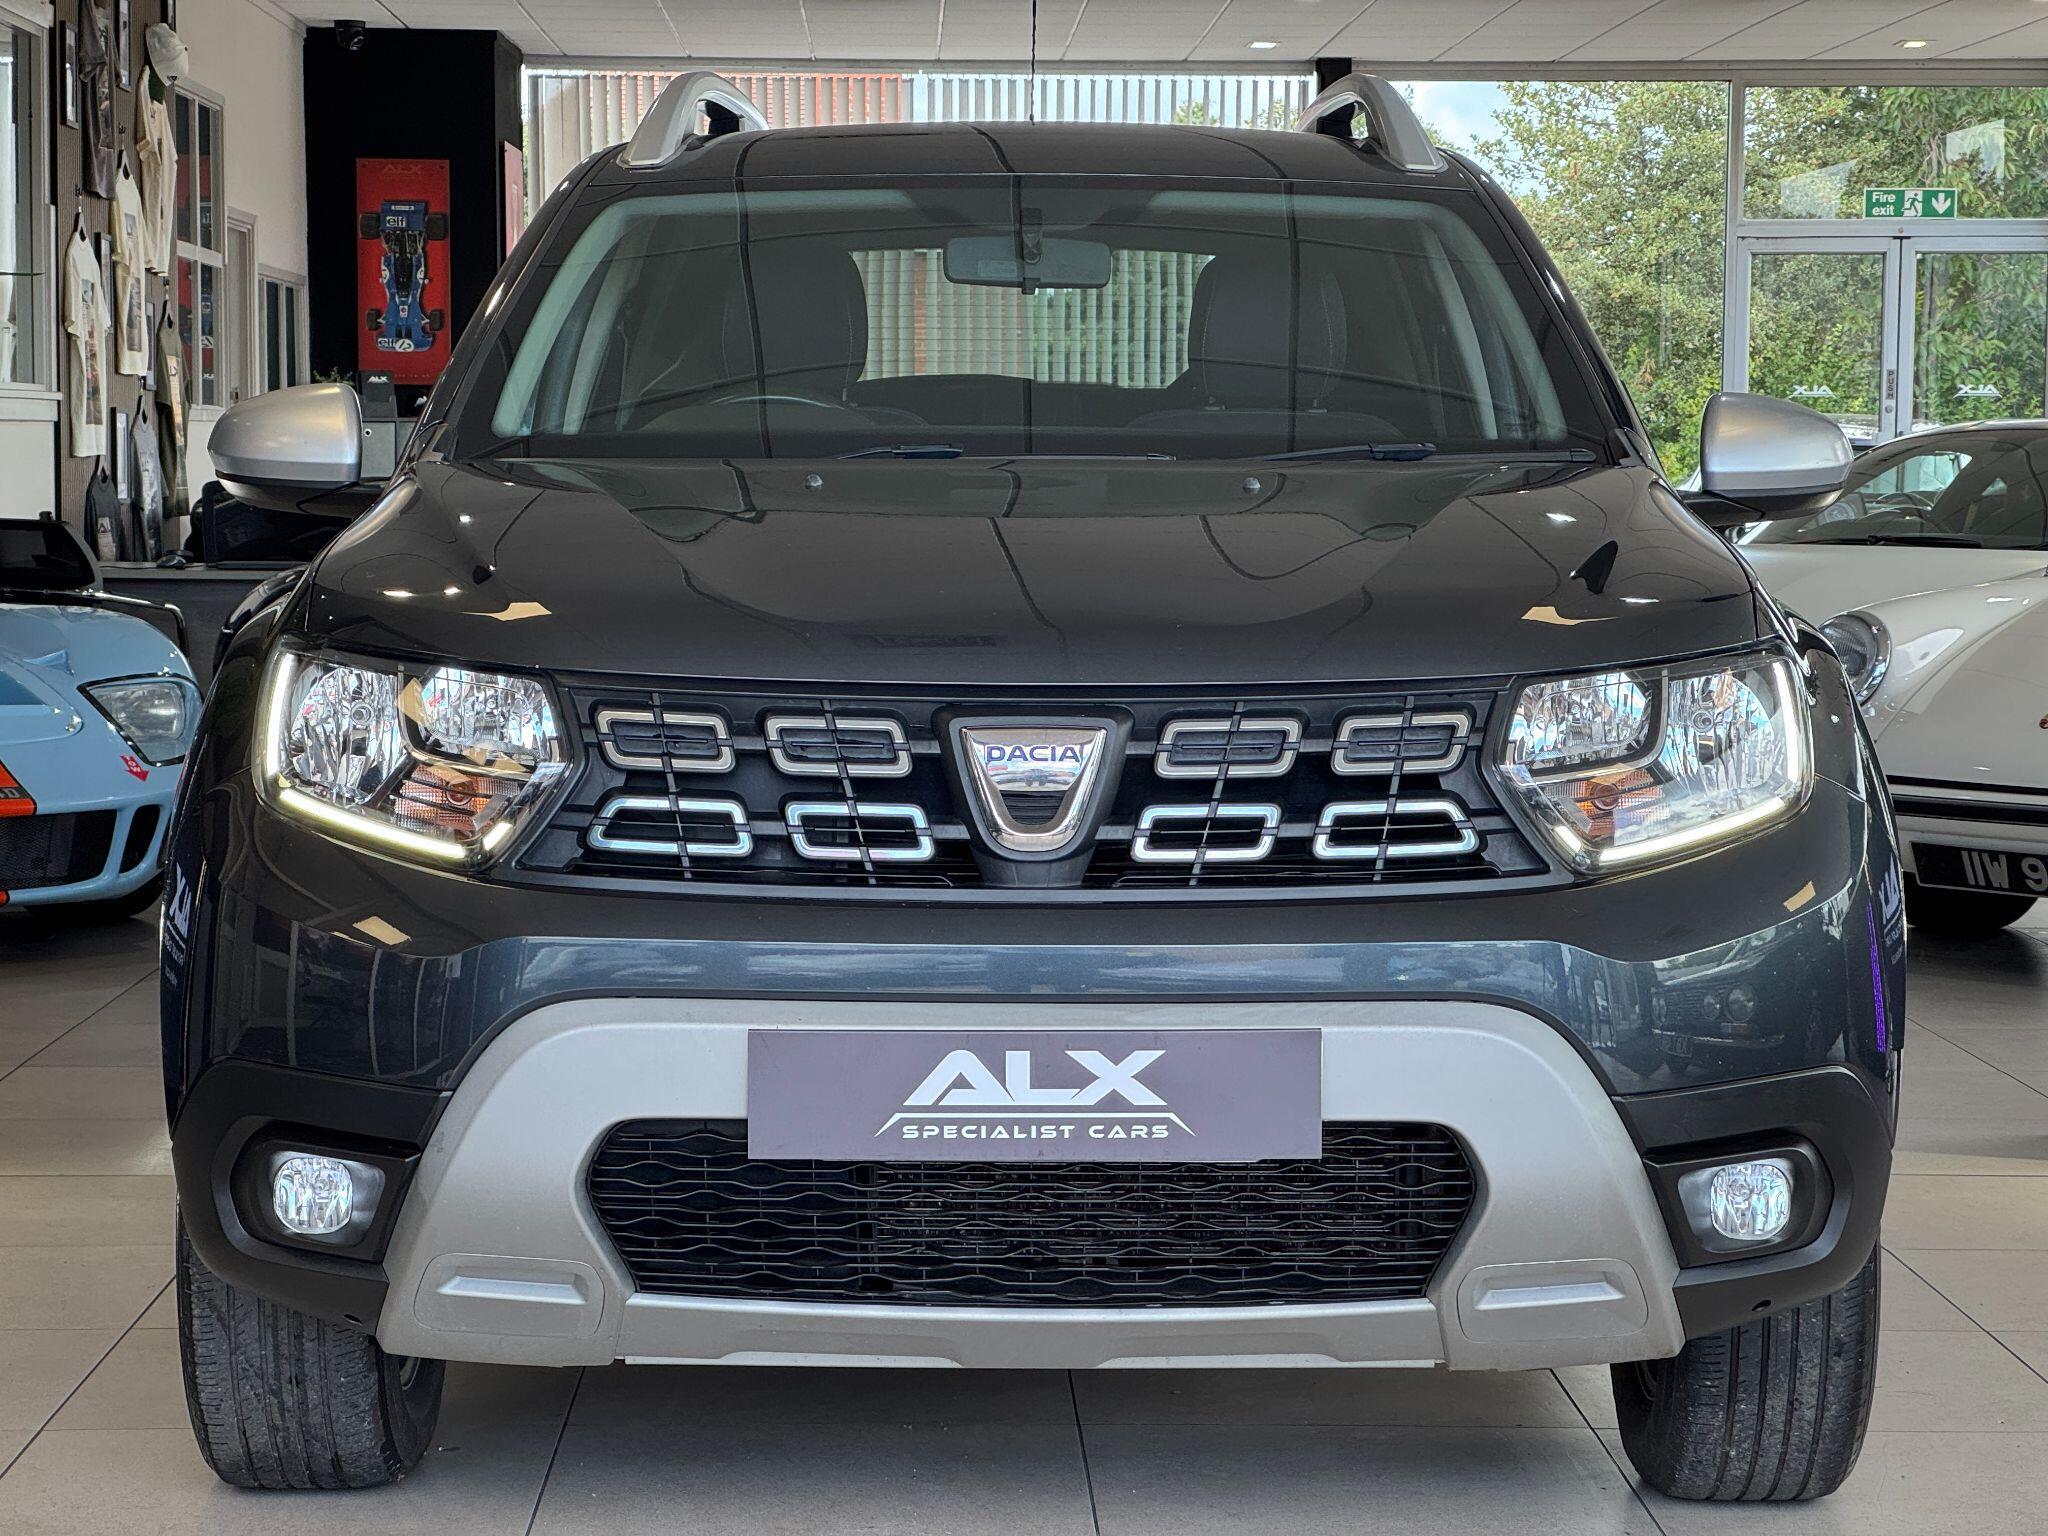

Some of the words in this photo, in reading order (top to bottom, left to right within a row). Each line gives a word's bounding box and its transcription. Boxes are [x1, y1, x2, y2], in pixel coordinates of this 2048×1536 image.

[1872, 191, 1896, 203] Fire
[1872, 204, 1895, 216] exit
[1887, 370, 1895, 399] PUSH
[986, 745, 1081, 762] DACIA
[902, 1048, 1169, 1107] ALX
[902, 1124, 1076, 1139] SPECIALIST
[1088, 1124, 1170, 1139] CARS
